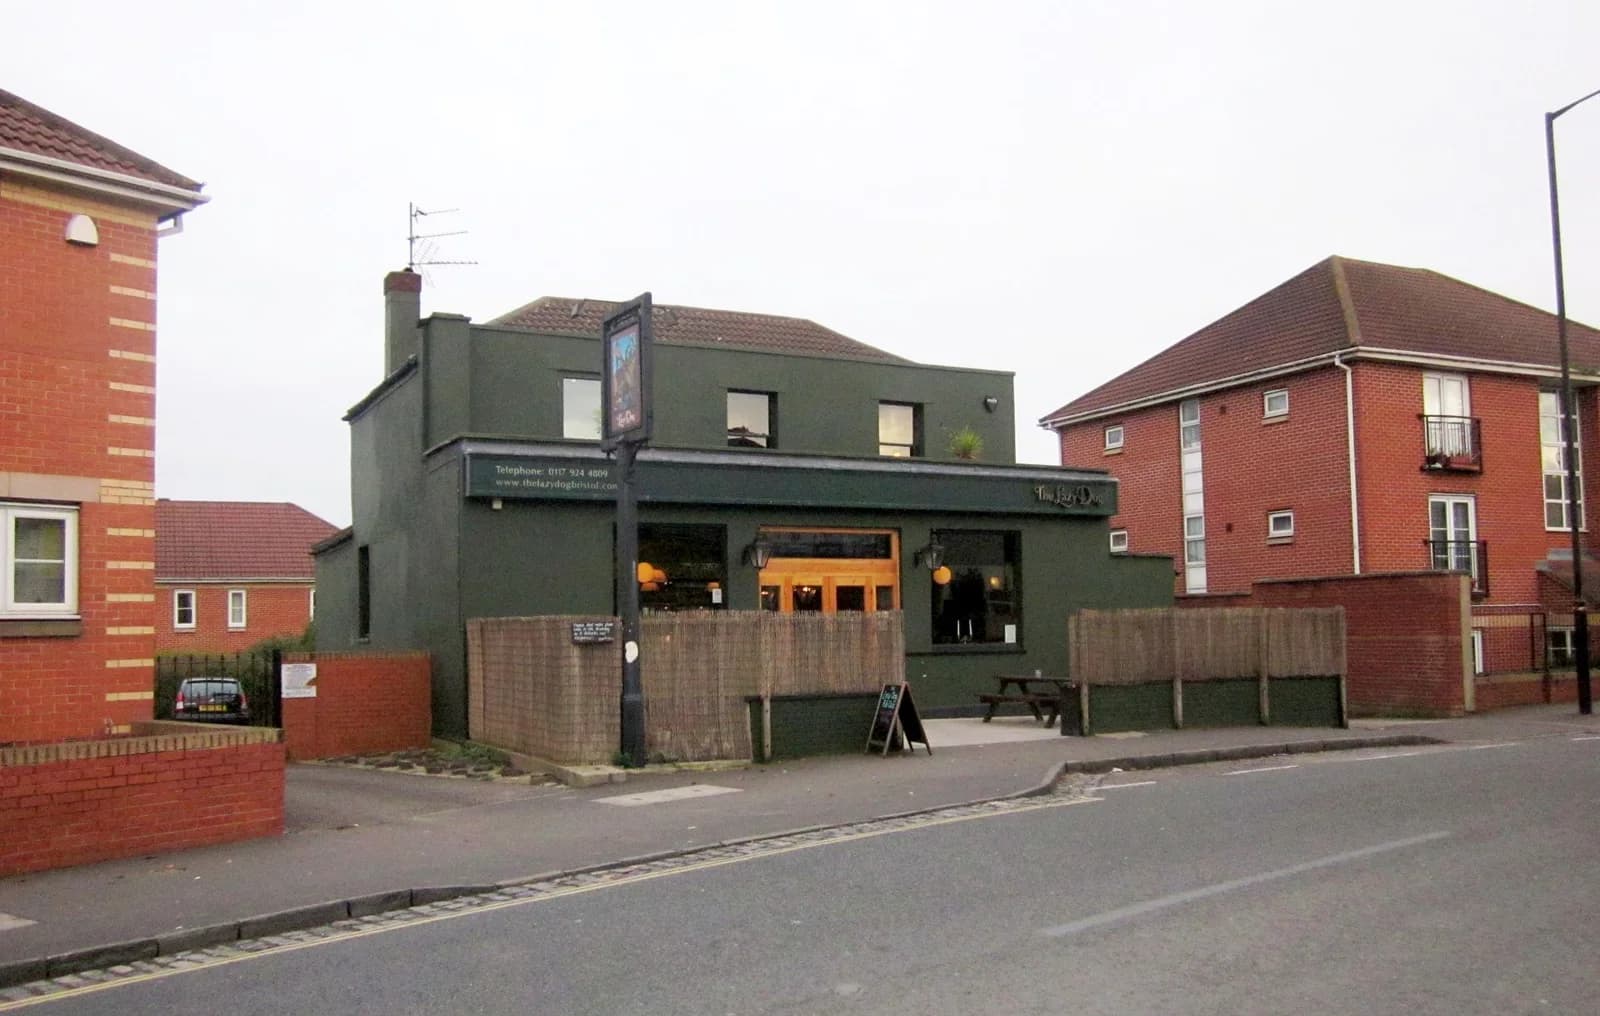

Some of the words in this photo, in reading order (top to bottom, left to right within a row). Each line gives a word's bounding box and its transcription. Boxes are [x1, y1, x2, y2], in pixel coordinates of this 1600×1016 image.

[495, 465, 544, 476] Telephone:
[548, 467, 567, 476] 0117
[570, 468, 585, 477] 924
[588, 469, 608, 478] 4809
